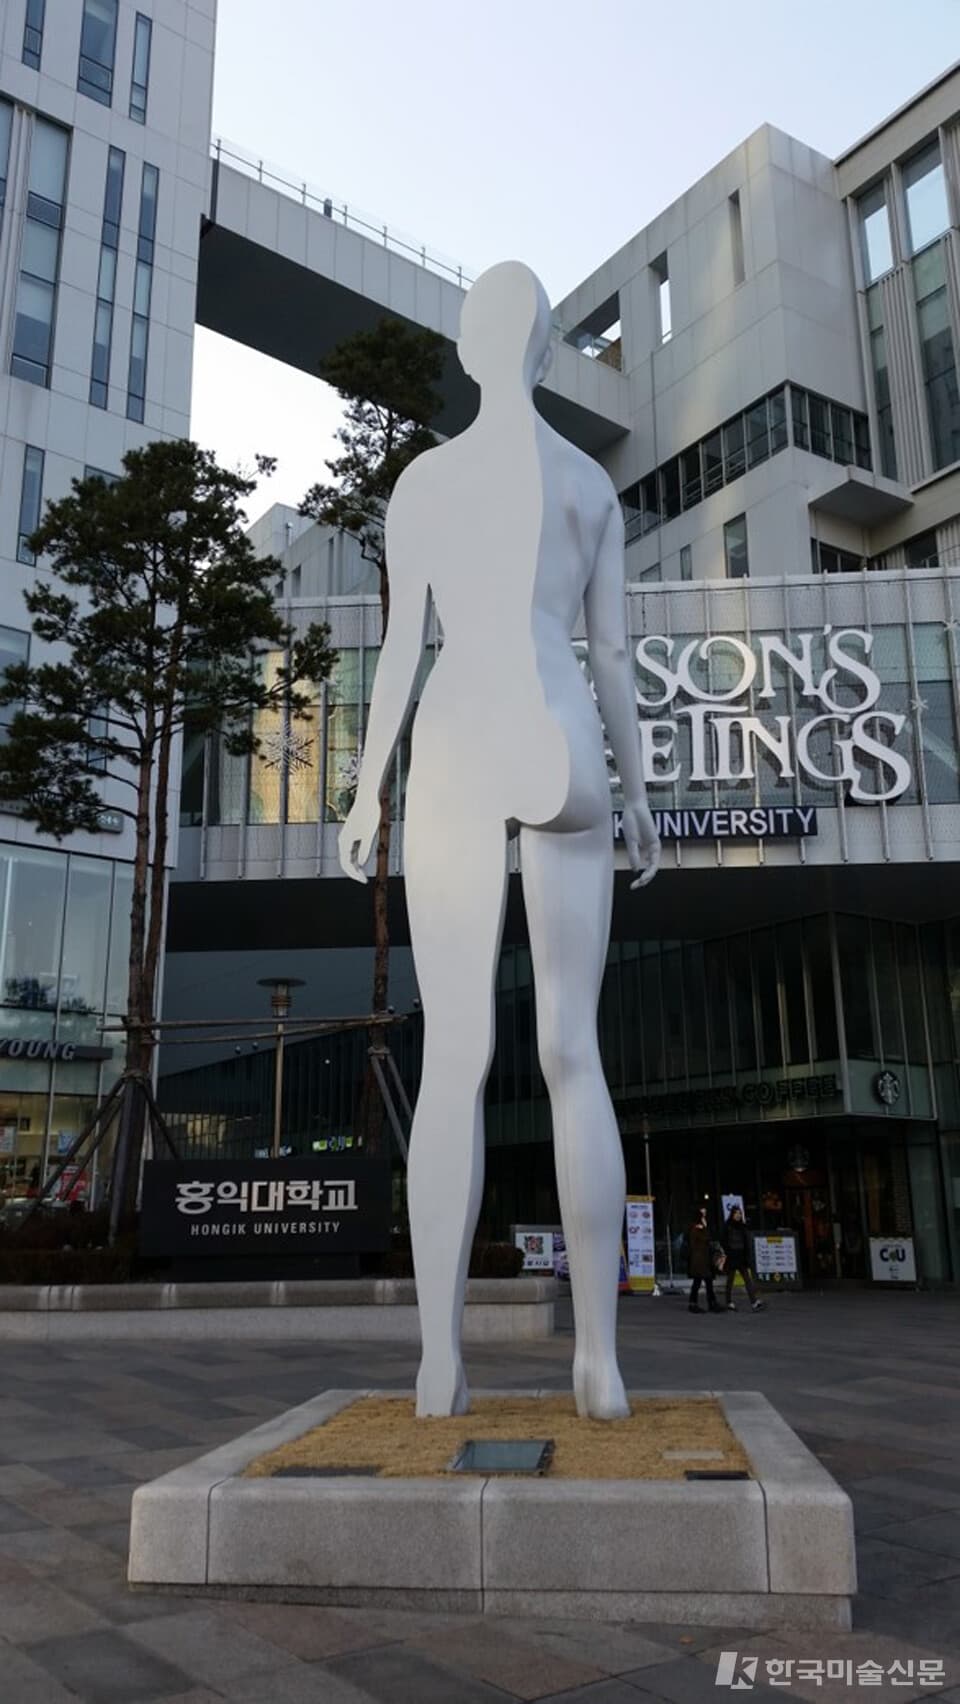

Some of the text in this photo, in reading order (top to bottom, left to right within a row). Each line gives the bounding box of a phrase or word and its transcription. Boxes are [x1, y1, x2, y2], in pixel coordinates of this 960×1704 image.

[572, 623, 881, 715] SON'S
[601, 703, 912, 801] ETINGS
[175, 1179, 359, 1215] 홍익대학교
[190, 1221, 341, 1236] HONGIK UNIVERSITY
